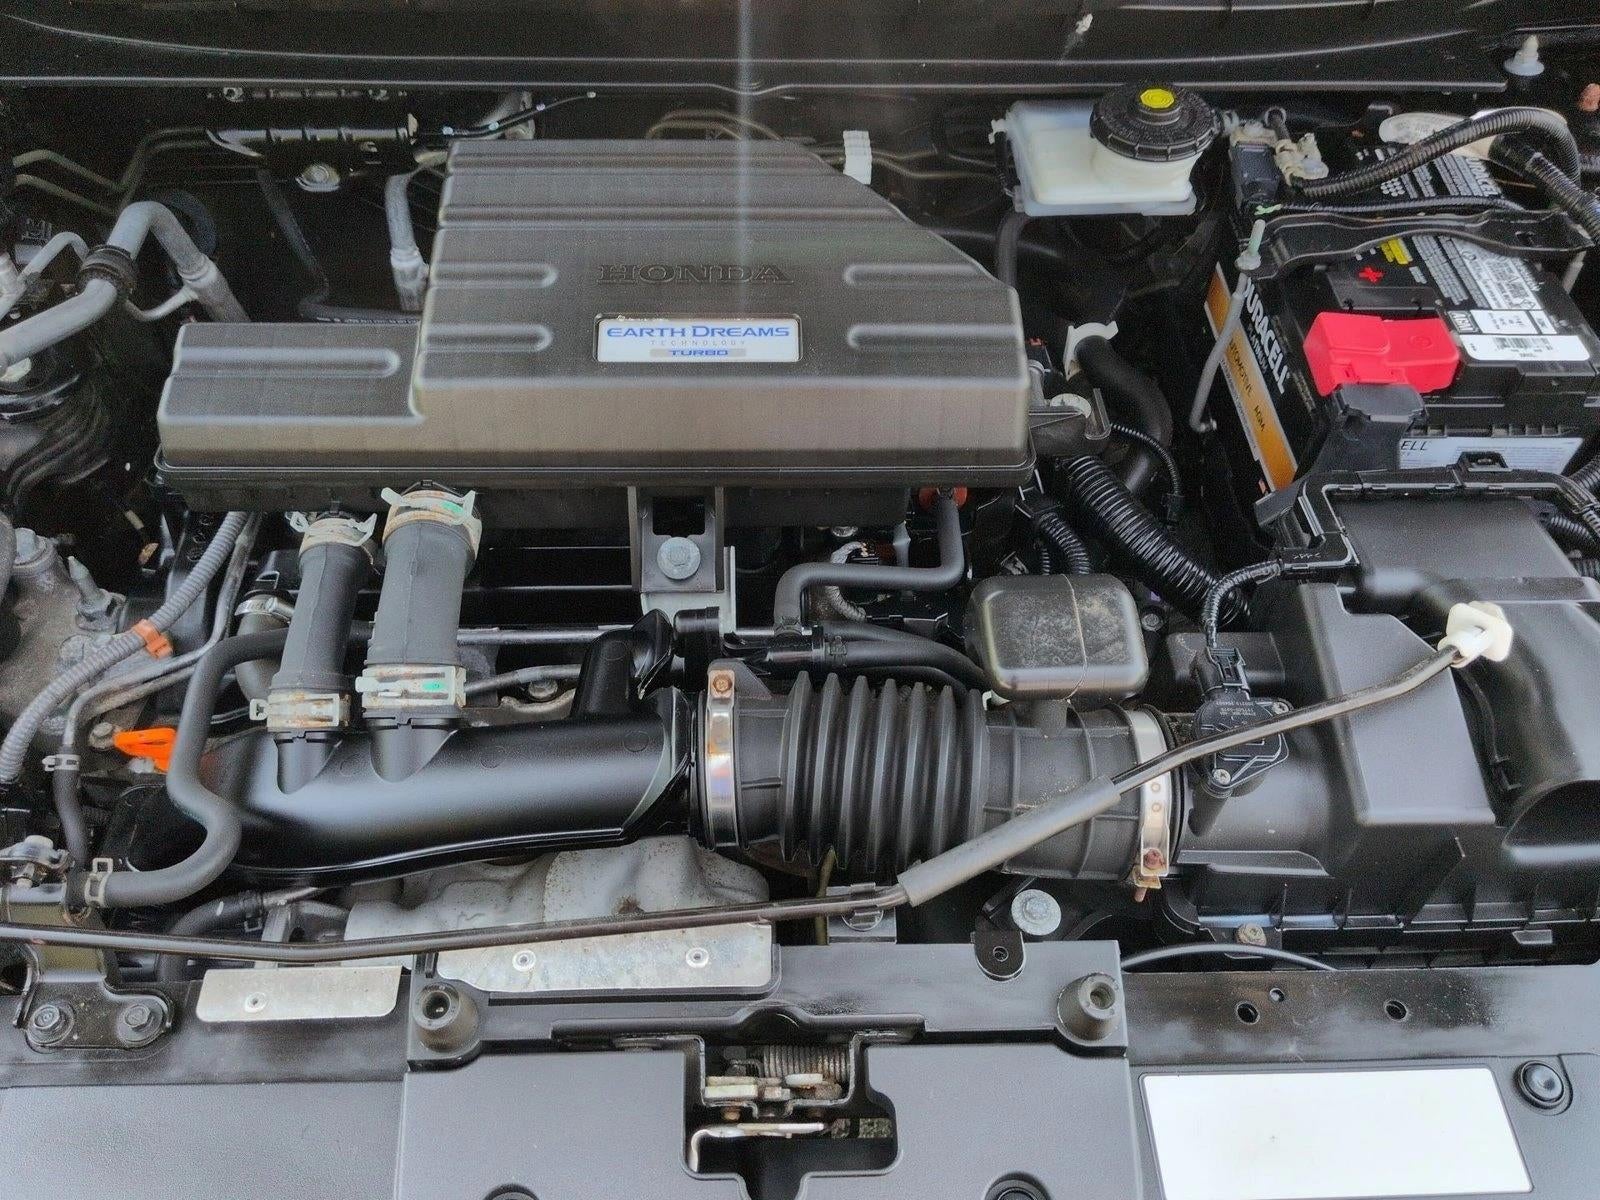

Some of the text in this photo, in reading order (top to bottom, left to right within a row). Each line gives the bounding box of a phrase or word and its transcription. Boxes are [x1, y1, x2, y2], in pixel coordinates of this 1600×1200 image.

[597, 264, 794, 285] HONDA
[606, 325, 790, 338] EARTH DREAMS
[668, 349, 729, 357] TURBO
